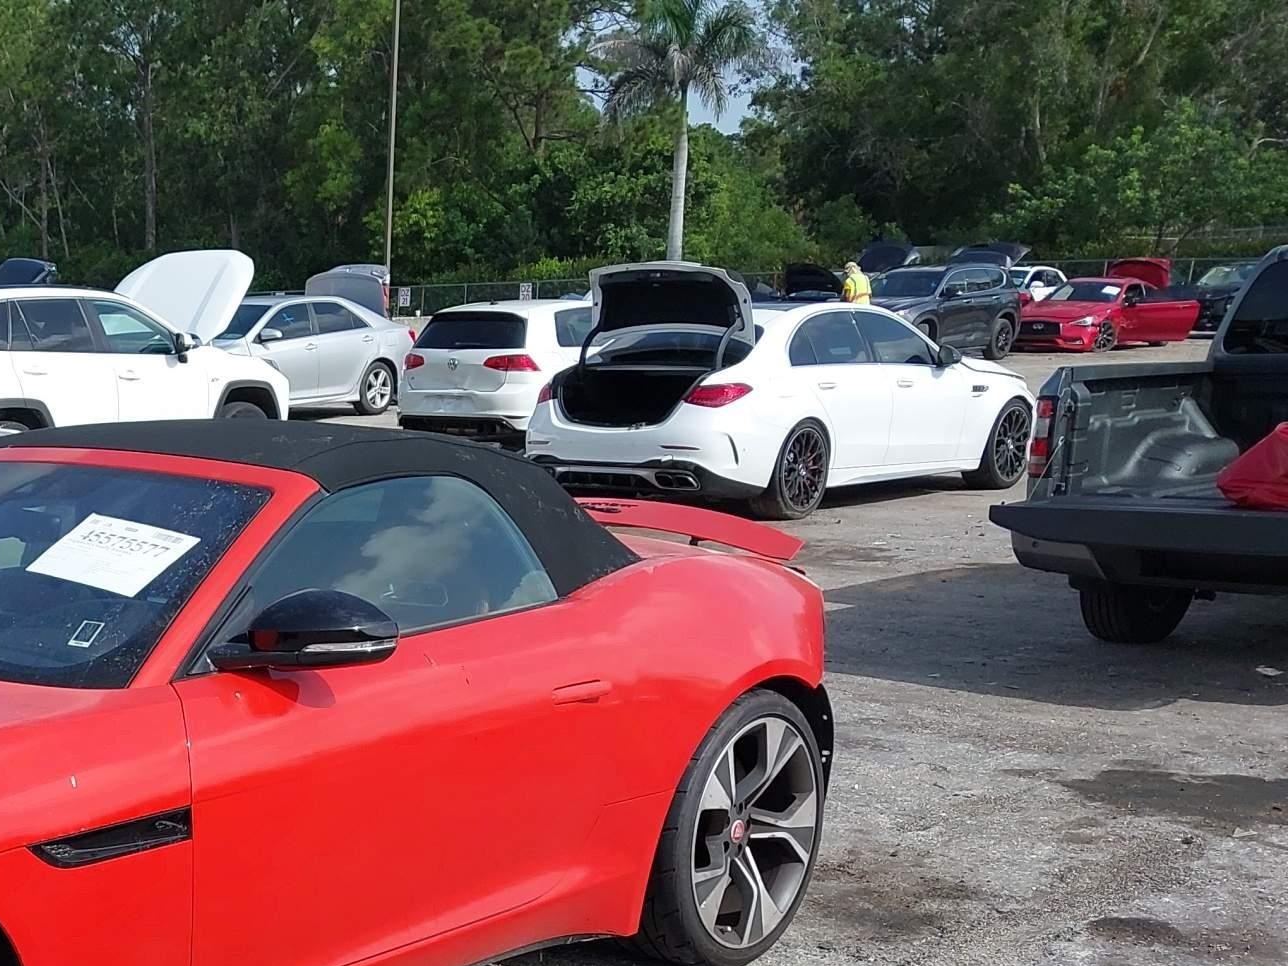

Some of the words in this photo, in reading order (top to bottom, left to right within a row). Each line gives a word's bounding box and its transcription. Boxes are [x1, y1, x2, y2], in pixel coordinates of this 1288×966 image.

[520, 284, 530, 293] DZ
[402, 297, 408, 305] 21
[80, 530, 171, 557] 45575577
